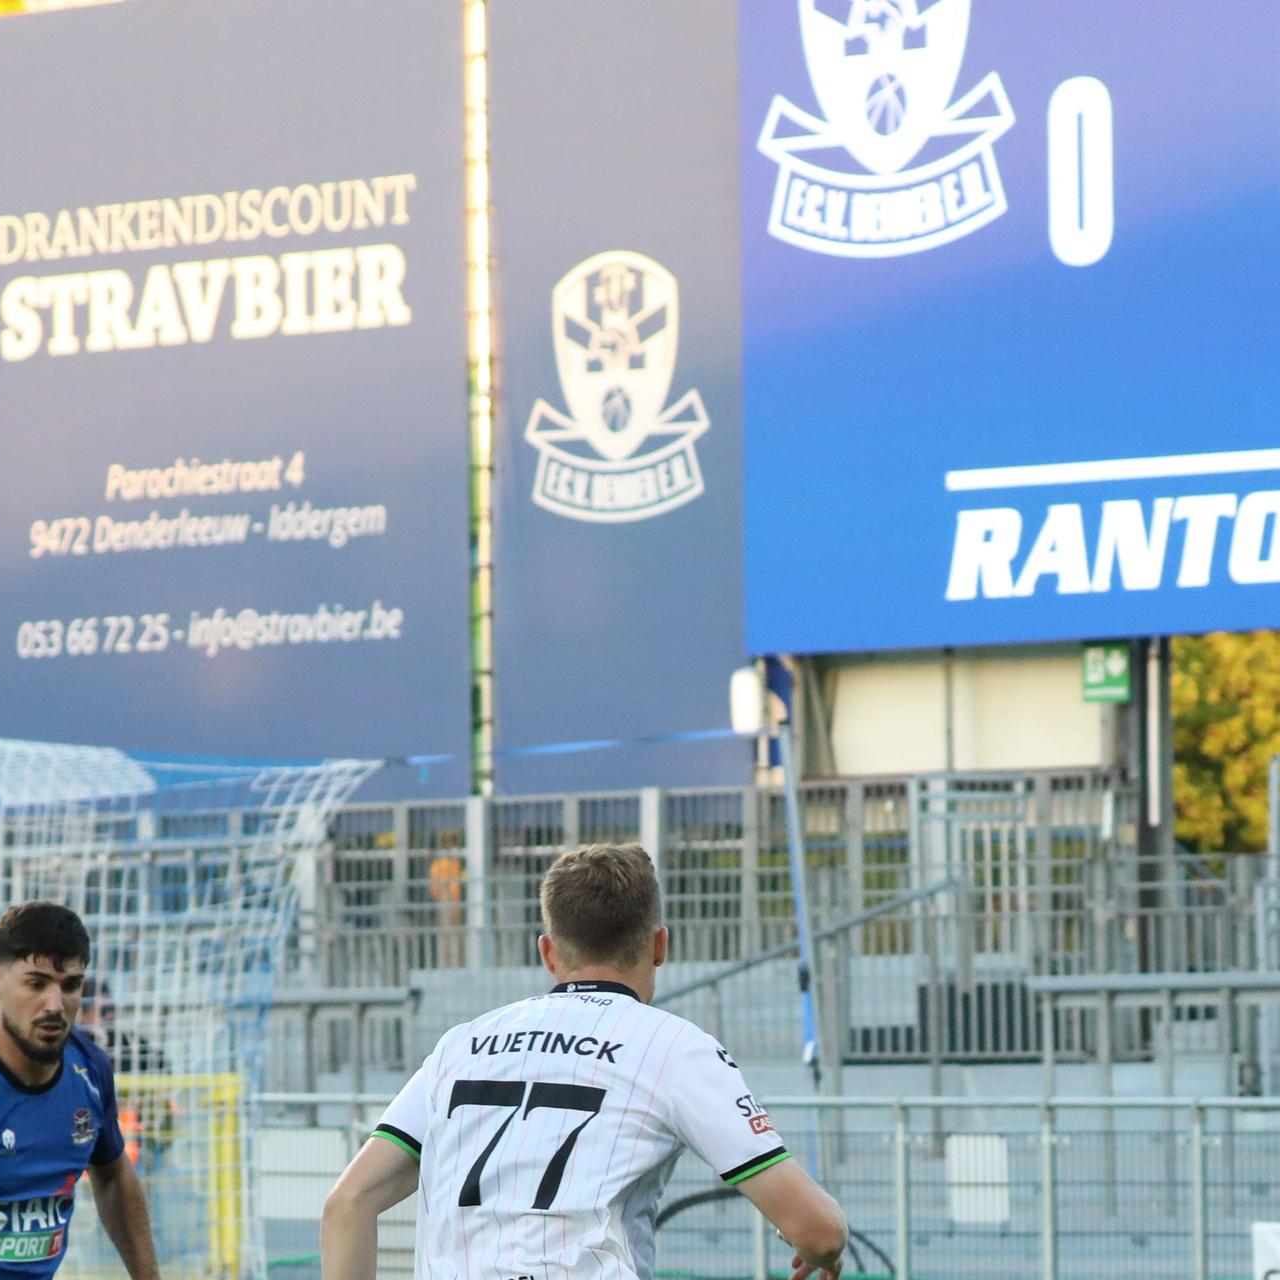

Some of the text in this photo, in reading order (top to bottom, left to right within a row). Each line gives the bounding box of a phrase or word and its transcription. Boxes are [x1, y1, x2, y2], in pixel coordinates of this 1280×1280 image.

[1047, 75, 1113, 267] 0
[0, 243, 411, 362] STRAVBIER
[104, 450, 306, 502] Parochiestraat 4
[29, 517, 92, 558] 9472
[93, 509, 251, 554] Denderleeuw
[267, 500, 388, 549] Iddergem
[17, 620, 64, 658] 053
[66, 617, 100, 656] 66
[102, 615, 135, 654] 72
[136, 612, 171, 652] 25
[187, 600, 404, 658] info@stravbier.be
[470, 1031, 624, 1064] VLIETINCK
[448, 1079, 607, 1210] 77
